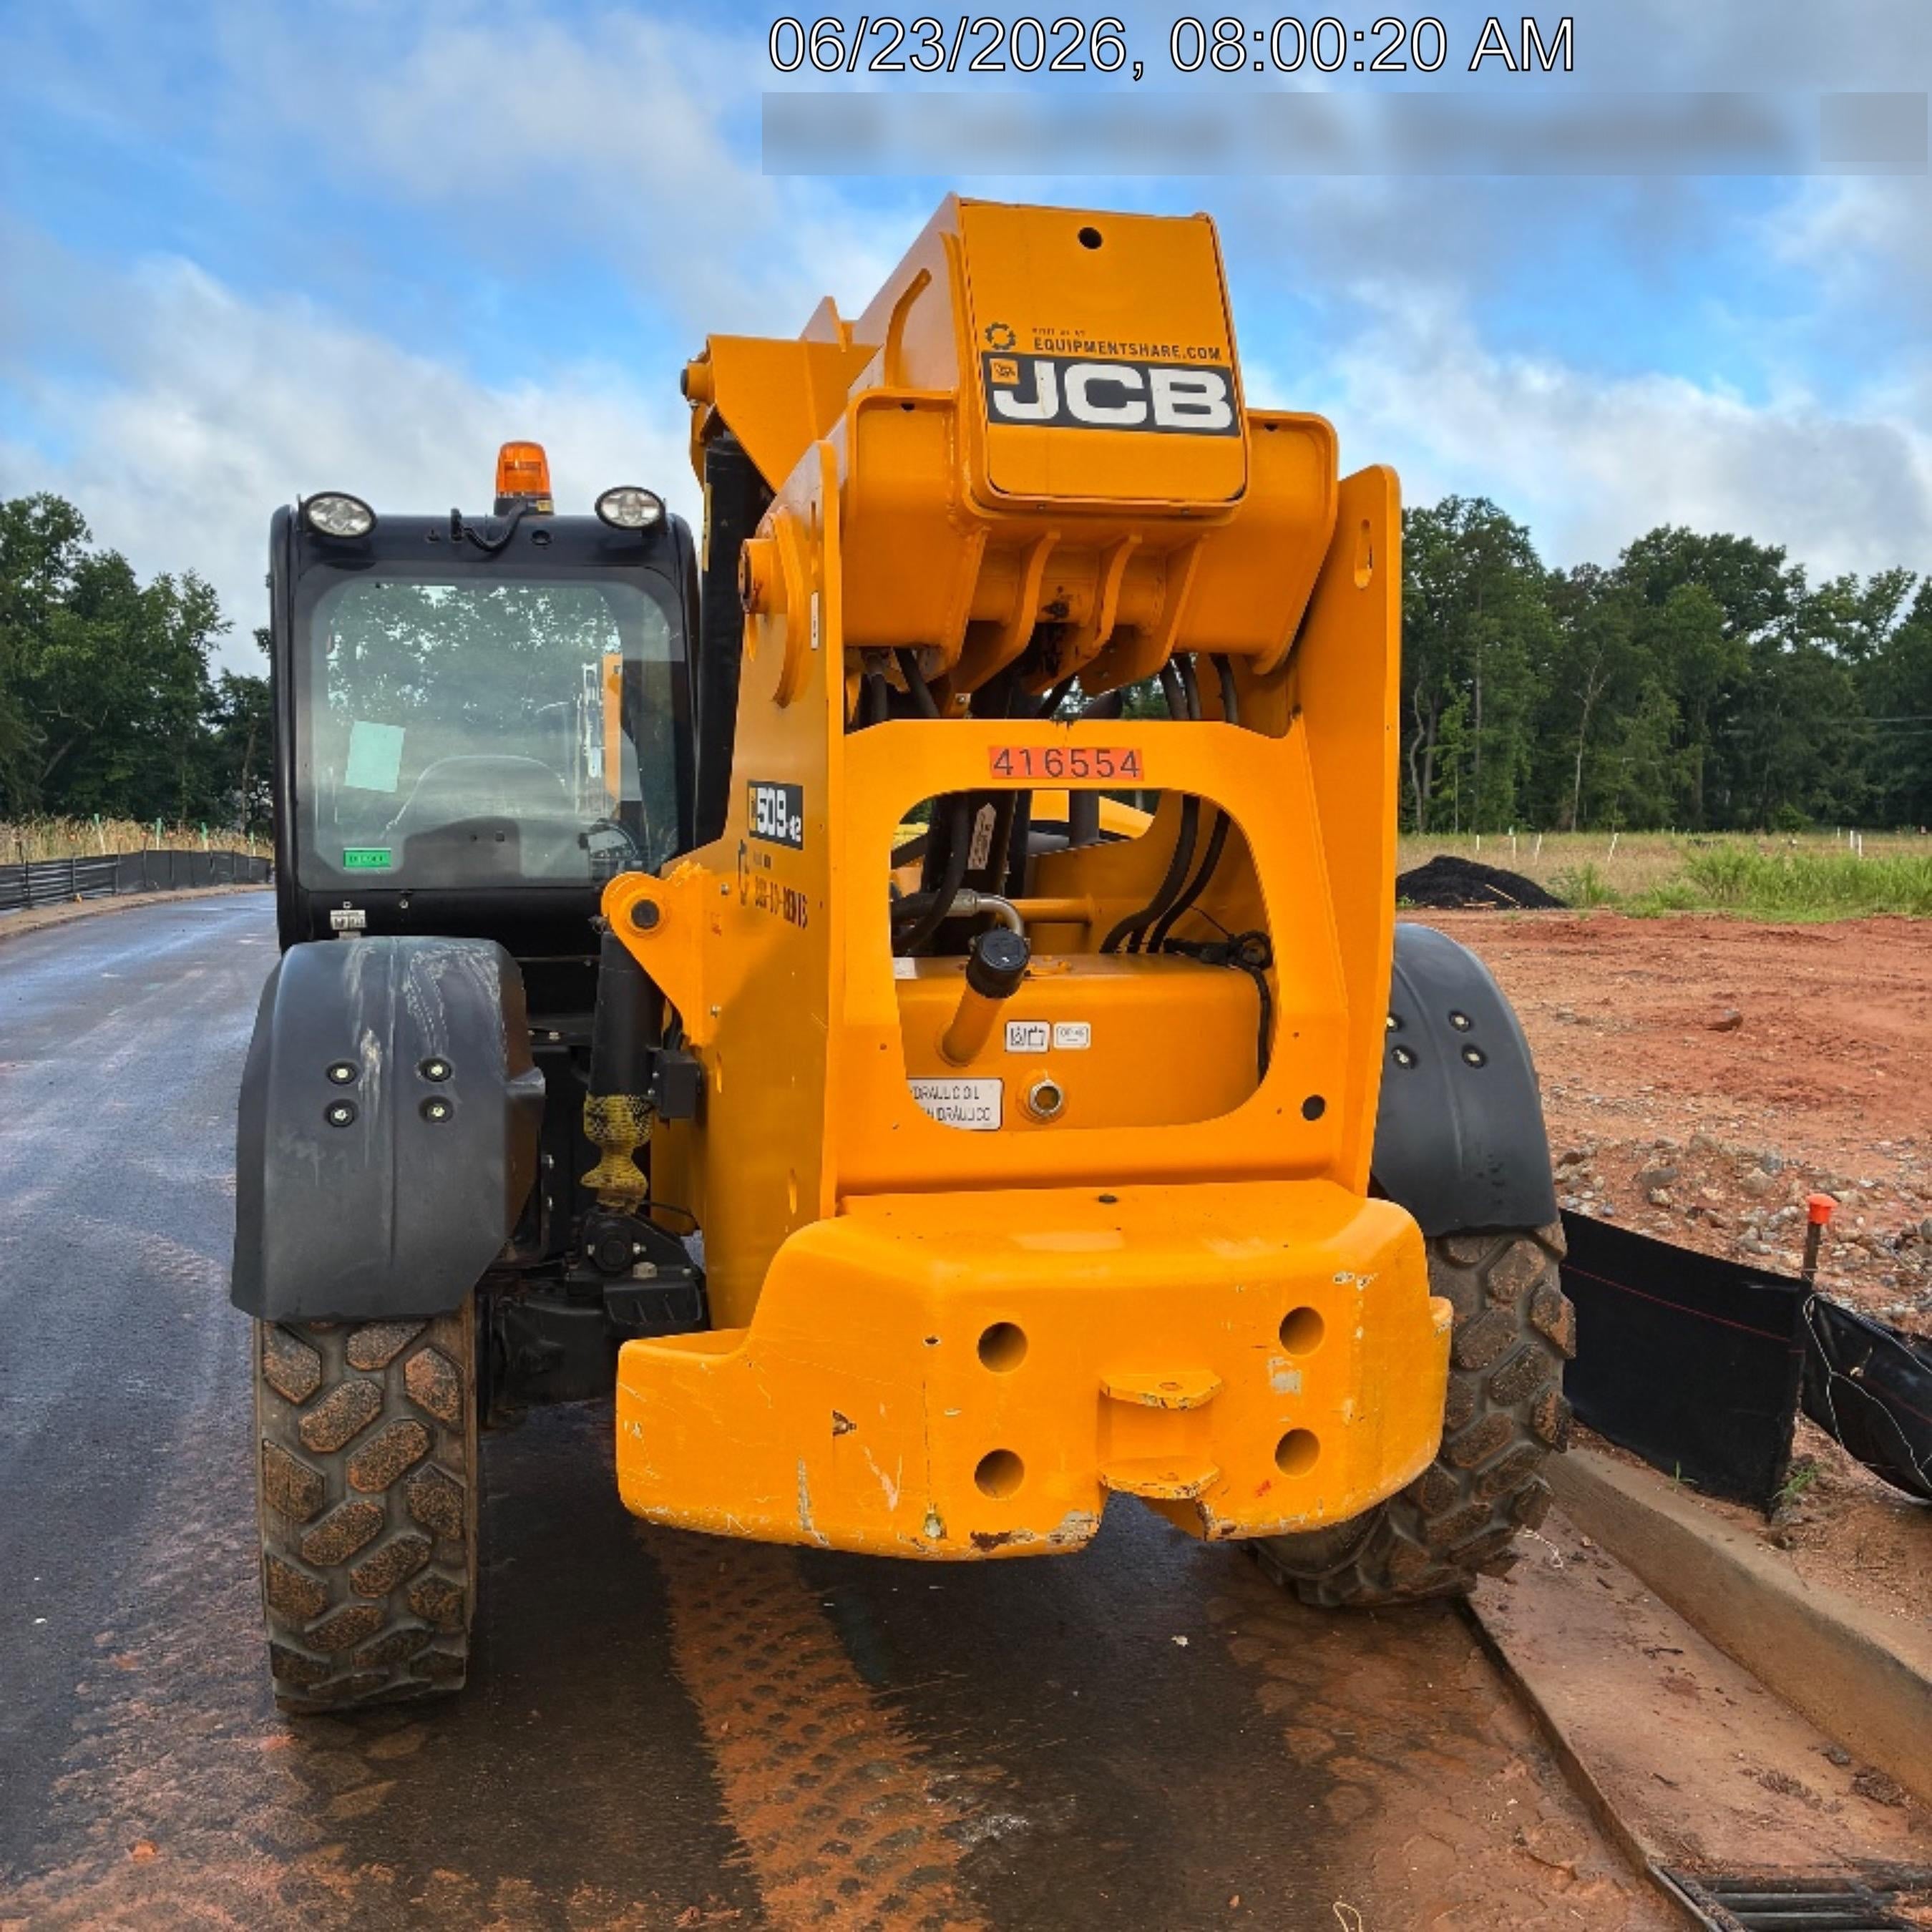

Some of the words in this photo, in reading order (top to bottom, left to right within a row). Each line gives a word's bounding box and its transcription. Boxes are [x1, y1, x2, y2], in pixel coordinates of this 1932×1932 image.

[1033, 337, 1221, 361] EQUIPMENTSHARE.COM
[992, 360, 1233, 429] JCB
[992, 748, 1141, 778] 416554
[963, 1085, 980, 1100] OL
